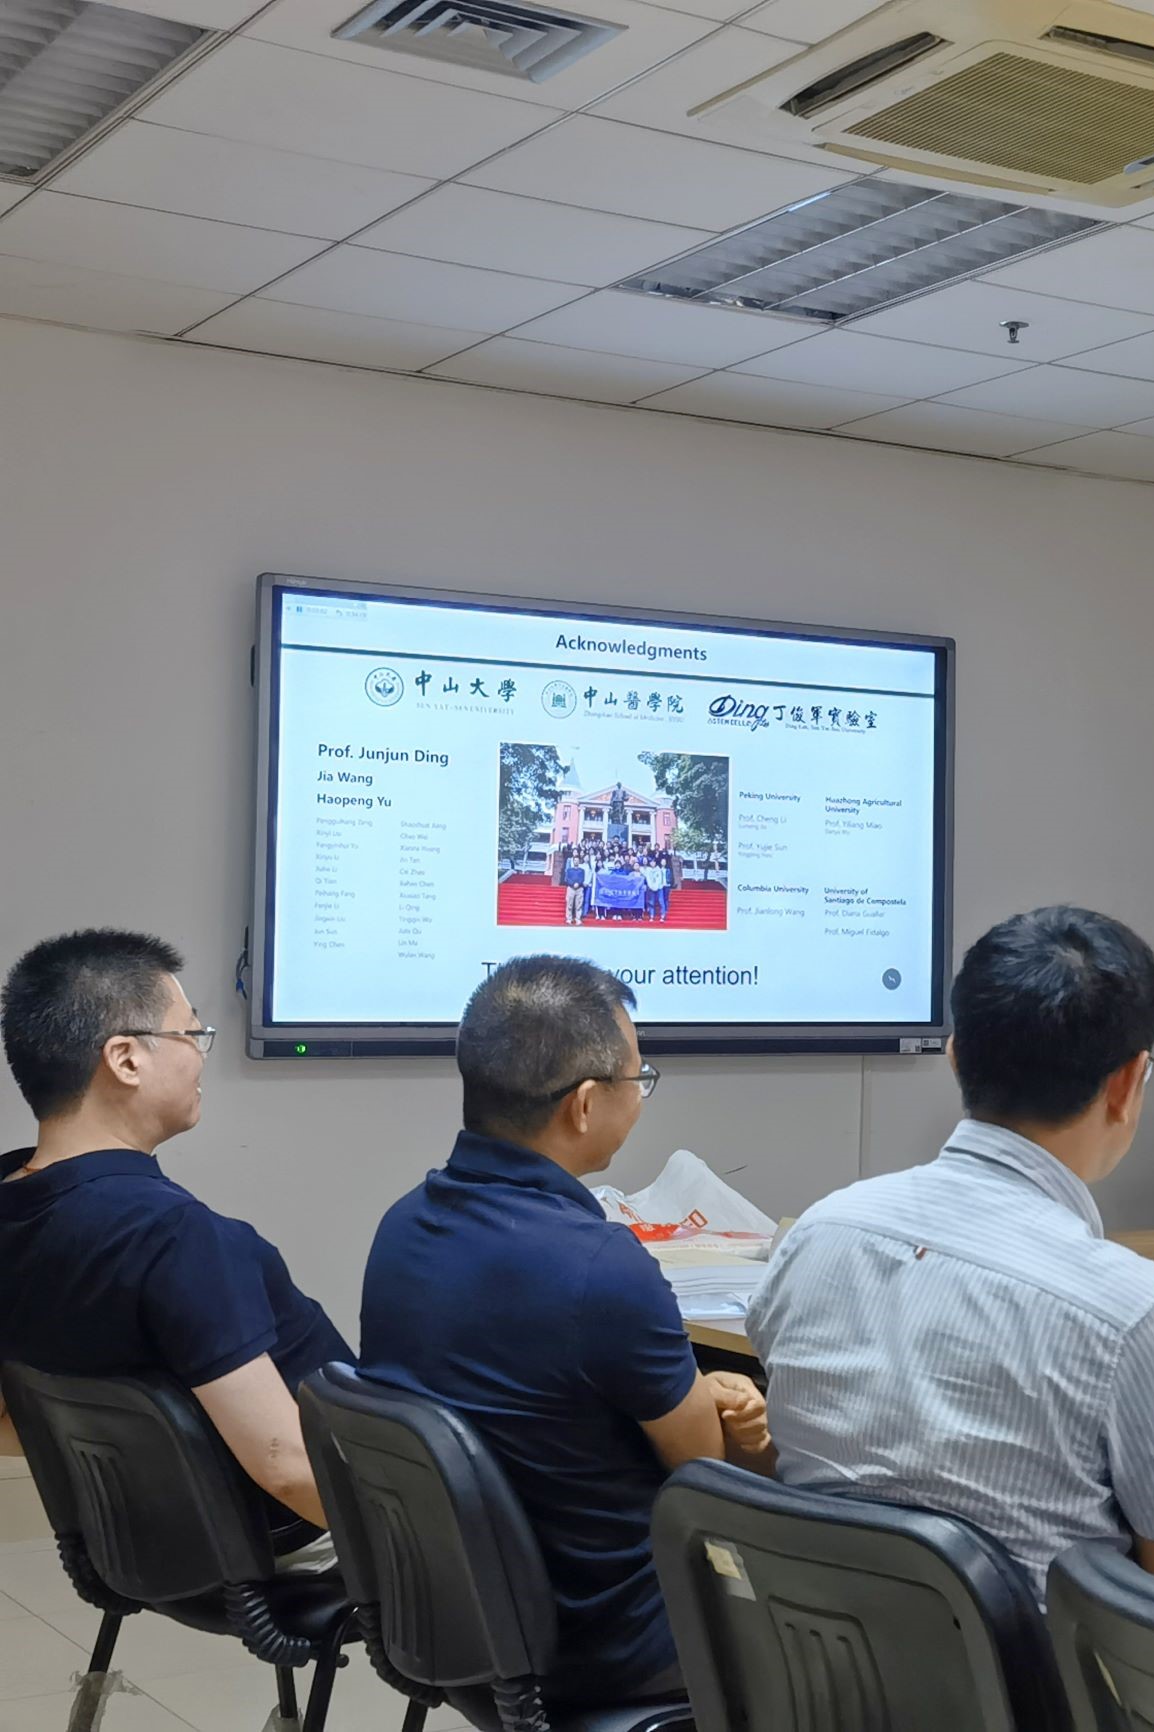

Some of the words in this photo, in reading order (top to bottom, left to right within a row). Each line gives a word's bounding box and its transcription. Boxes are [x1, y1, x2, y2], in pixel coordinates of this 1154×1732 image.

[556, 634, 707, 661] Acknowledgments
[415, 670, 517, 702] 中山大學
[708, 694, 769, 725] Ding
[318, 743, 353, 758] Prof.
[358, 746, 409, 764] Junjun
[414, 749, 449, 767] Ding
[317, 770, 334, 782] Jia
[337, 771, 373, 787] Wang
[317, 793, 373, 809] Haopeng
[377, 796, 392, 807] Yu
[739, 791, 763, 801] Peking
[765, 793, 801, 803] University
[825, 796, 860, 806] Huazhong
[862, 798, 902, 807] Agricultural
[825, 806, 859, 815] University
[757, 814, 778, 824] Cheng
[737, 884, 771, 892] Columbia
[773, 885, 809, 895] University
[824, 887, 859, 896] University
[860, 887, 869, 895] of
[824, 896, 855, 905] Santiago
[866, 897, 906, 906] Compostela
[785, 908, 805, 917] Wang
[841, 928, 864, 937] Miguel
[866, 928, 890, 937] Fidalgo
[662, 965, 759, 986] attention!
